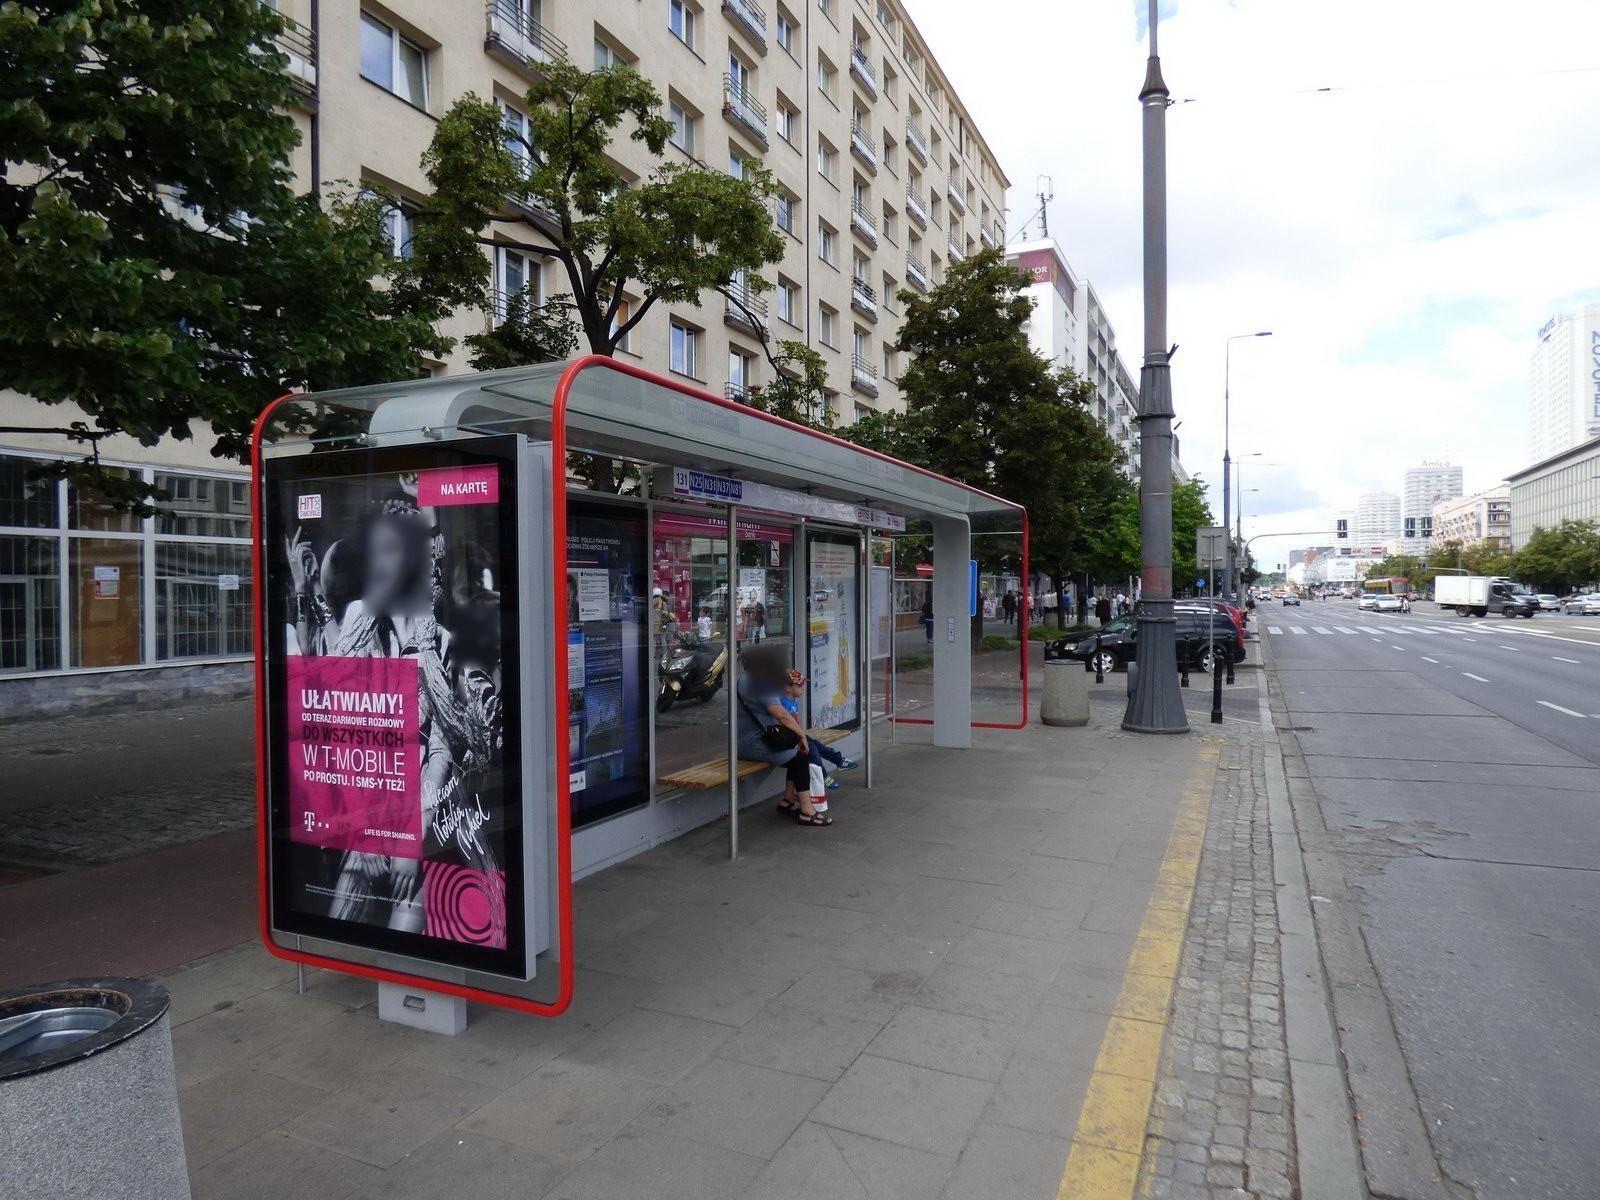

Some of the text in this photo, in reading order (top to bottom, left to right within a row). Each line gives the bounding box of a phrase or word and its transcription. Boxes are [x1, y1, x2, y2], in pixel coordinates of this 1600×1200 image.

[441, 481, 488, 495] NA KARTĘ
[676, 472, 688, 485] 131
[689, 474, 703, 488] N25
[704, 477, 716, 491] N31
[717, 480, 729, 493] N37
[299, 496, 314, 510] HIT
[301, 689, 404, 715] UŁATWIAMY!
[302, 712, 405, 728] OD TERAZ DARMOWE ROZMOWY
[303, 725, 404, 748] DO WSZYSTKICH
[302, 743, 405, 775] W T-MOBILE
[304, 770, 405, 792] PO PROSTU. I SMS-Y TEŻ!
[364, 828, 416, 841] LIFE IS FOR SHARING.
